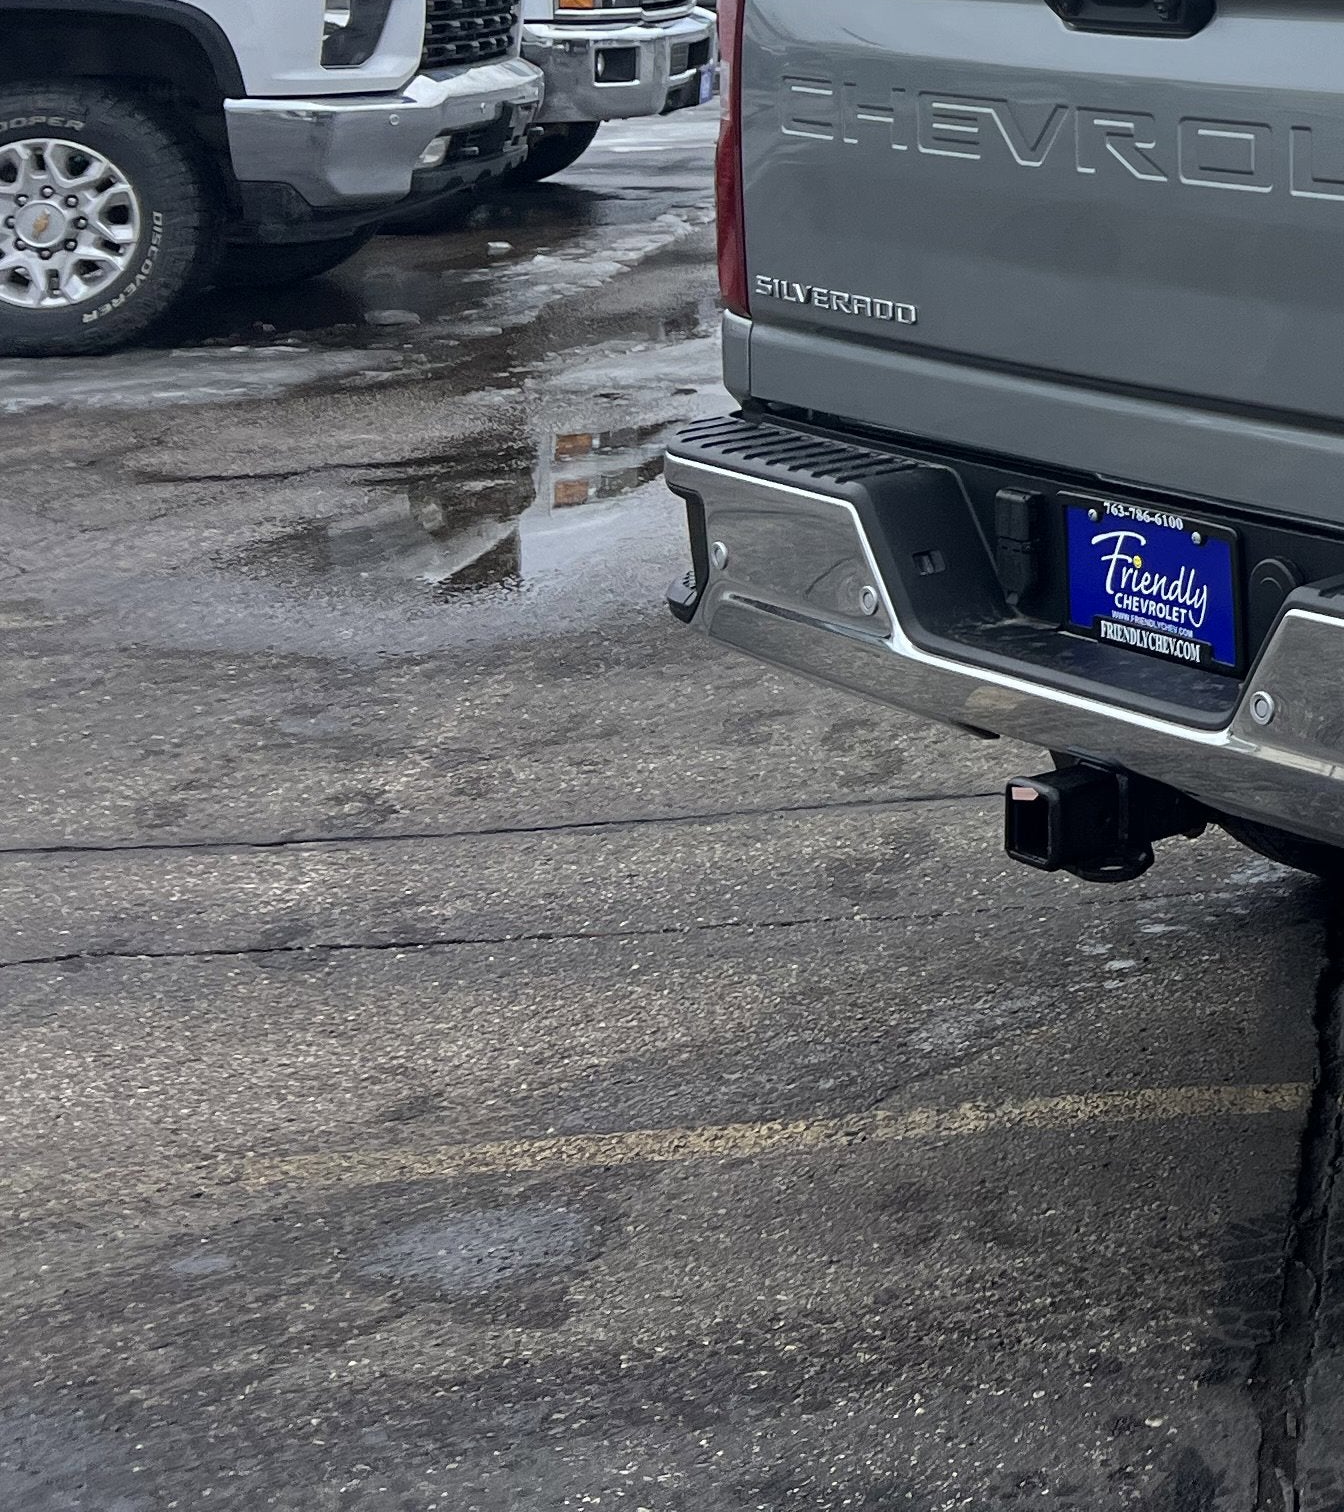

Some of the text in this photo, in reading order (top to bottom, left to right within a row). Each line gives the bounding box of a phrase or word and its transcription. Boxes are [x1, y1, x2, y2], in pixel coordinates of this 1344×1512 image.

[82, 211, 164, 324] DISCOVERER
[755, 274, 918, 325] SILVERADO
[1103, 502, 1184, 531] 763-786-6100
[1091, 530, 1208, 628] Friendly
[1114, 592, 1188, 624] CHEVROLET
[1100, 620, 1201, 663] FRIENDLYCHEV.COM
